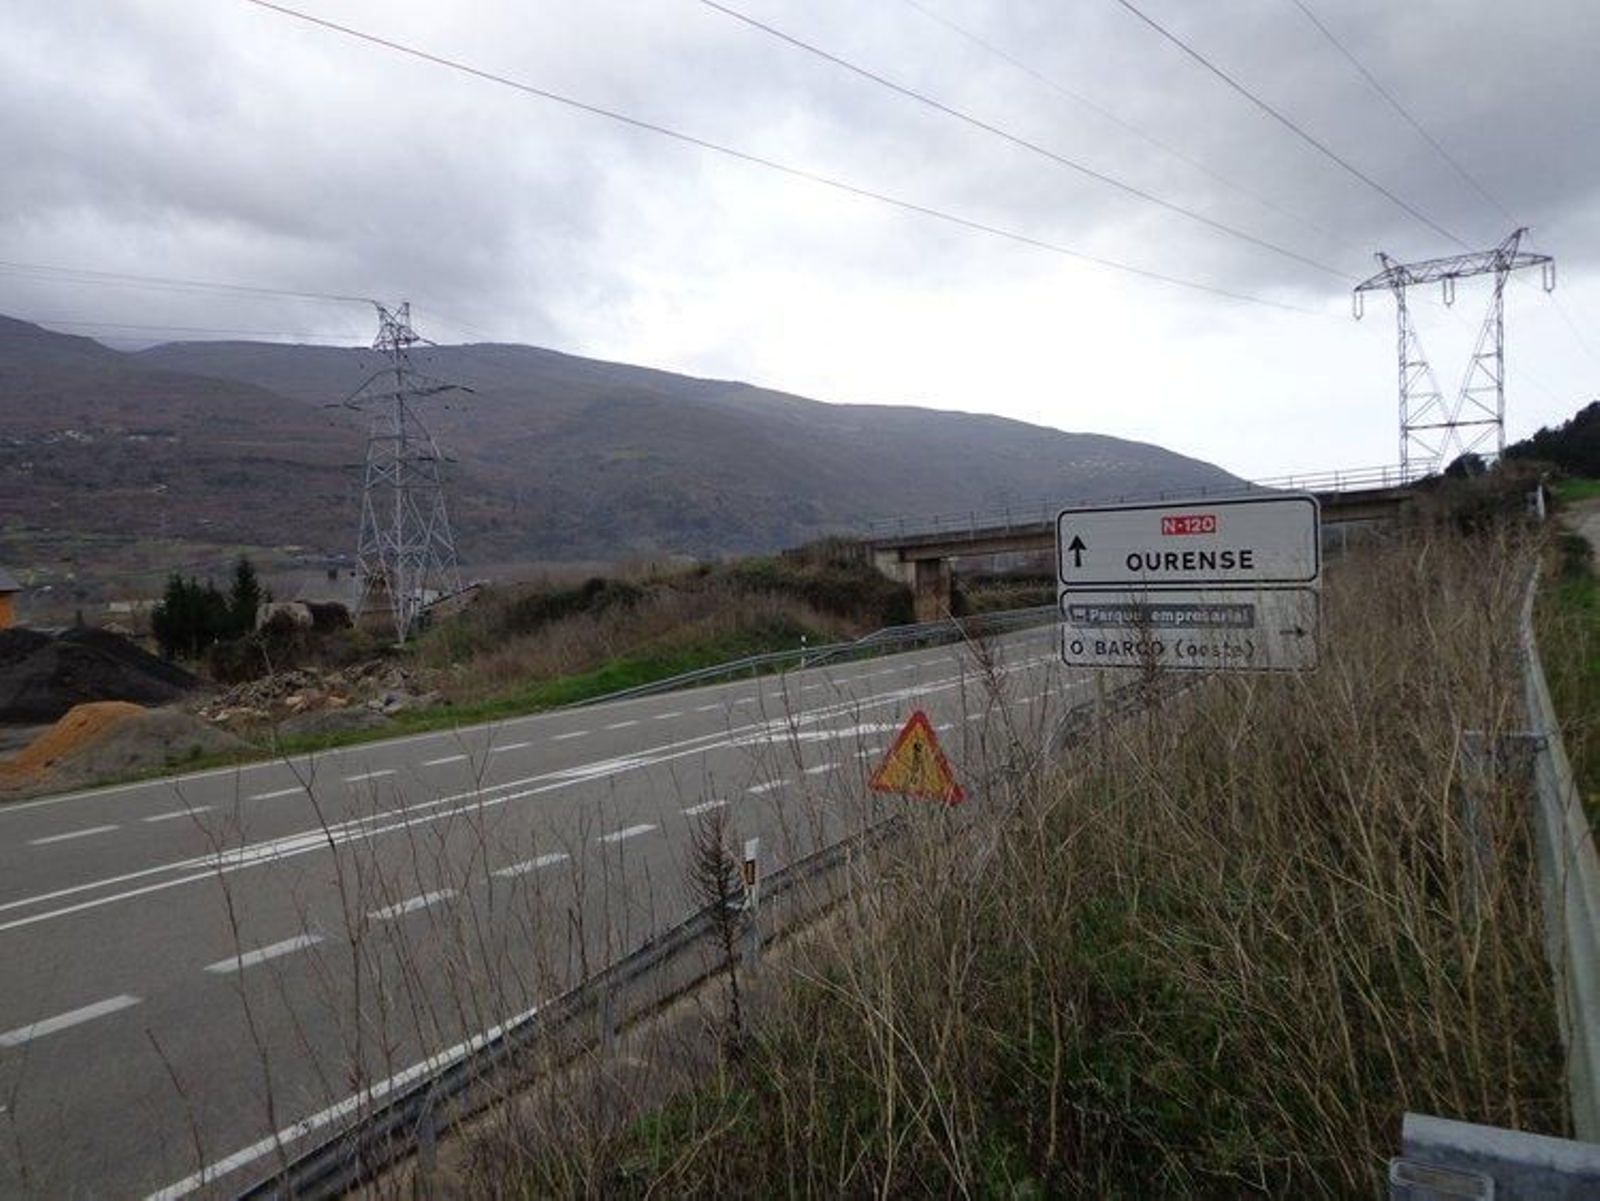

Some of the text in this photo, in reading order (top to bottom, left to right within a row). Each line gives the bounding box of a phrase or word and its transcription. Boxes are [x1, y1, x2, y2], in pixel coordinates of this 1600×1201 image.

[1163, 517, 1215, 533] N-120
[1126, 551, 1254, 571] OURENSE
[1071, 641, 1084, 655] O
